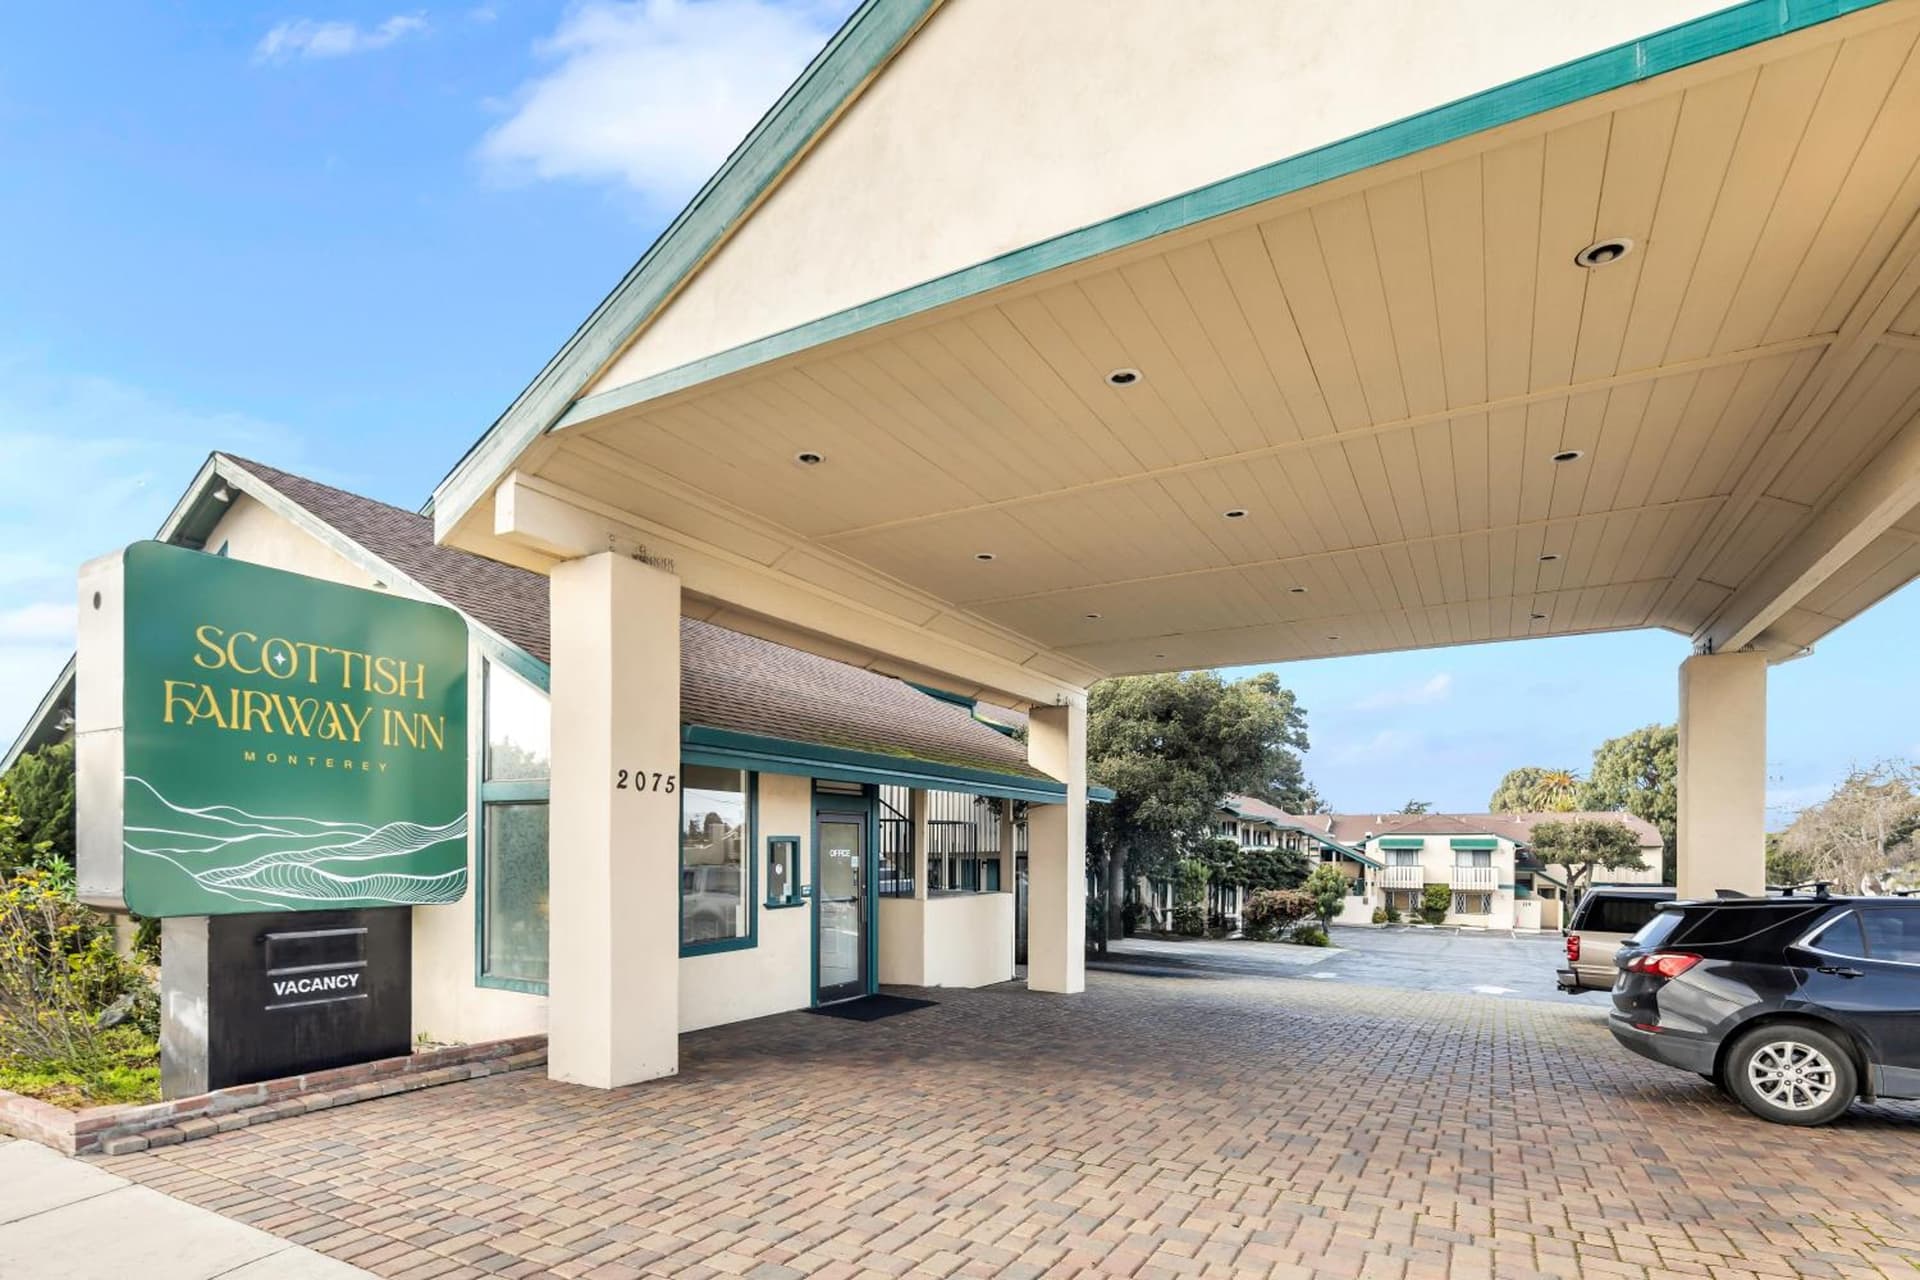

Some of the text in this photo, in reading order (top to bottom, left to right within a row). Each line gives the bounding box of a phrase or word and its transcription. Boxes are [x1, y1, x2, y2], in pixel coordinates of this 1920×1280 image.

[194, 625, 425, 699] SCOTTISH
[163, 680, 445, 751] FAIRWAY INN
[244, 751, 388, 772] MONTEREY
[616, 769, 676, 793] 2075
[829, 848, 851, 857] OFFICE
[273, 973, 360, 996] VACANCY
